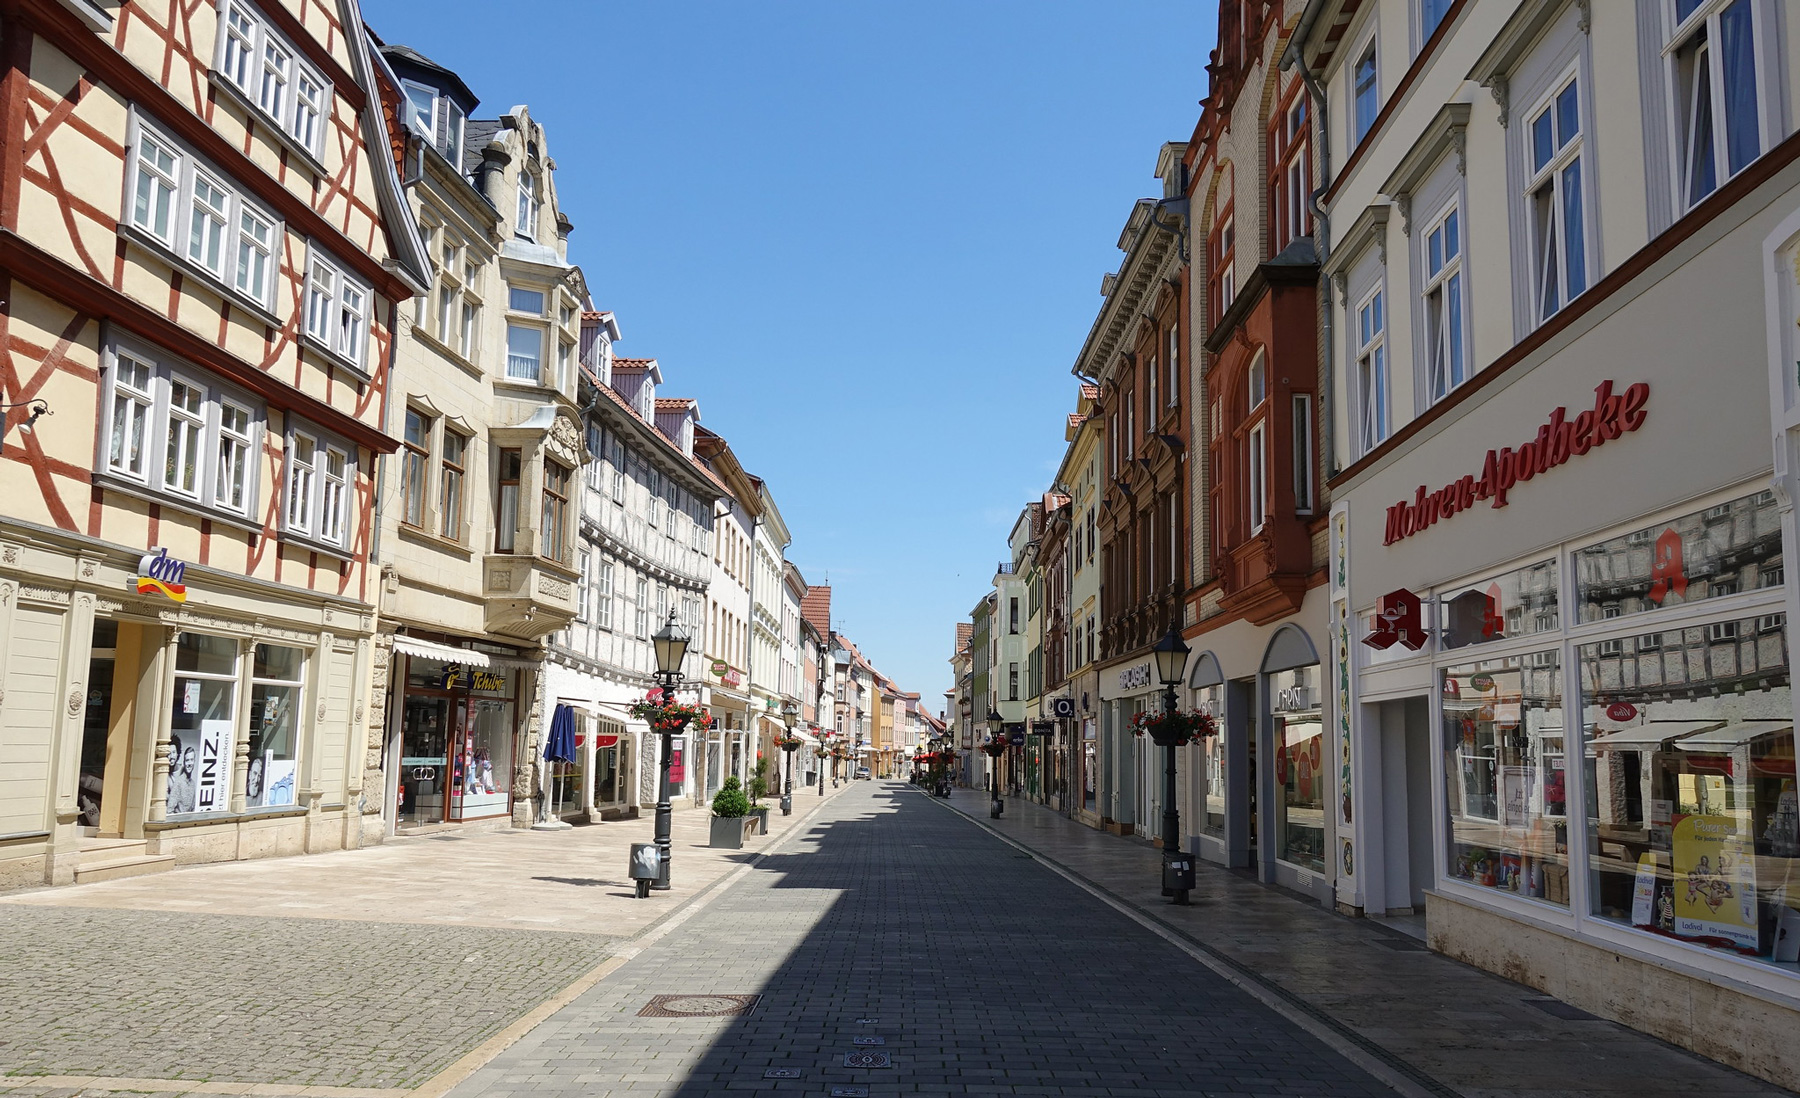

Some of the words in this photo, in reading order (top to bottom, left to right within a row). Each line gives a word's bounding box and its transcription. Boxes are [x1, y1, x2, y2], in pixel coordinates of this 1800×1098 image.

[1382, 380, 1650, 547] Mohren-Apotheke
[149, 547, 186, 583] dm
[472, 671, 505, 691] Tchibo
[199, 731, 219, 811] EINZ.
